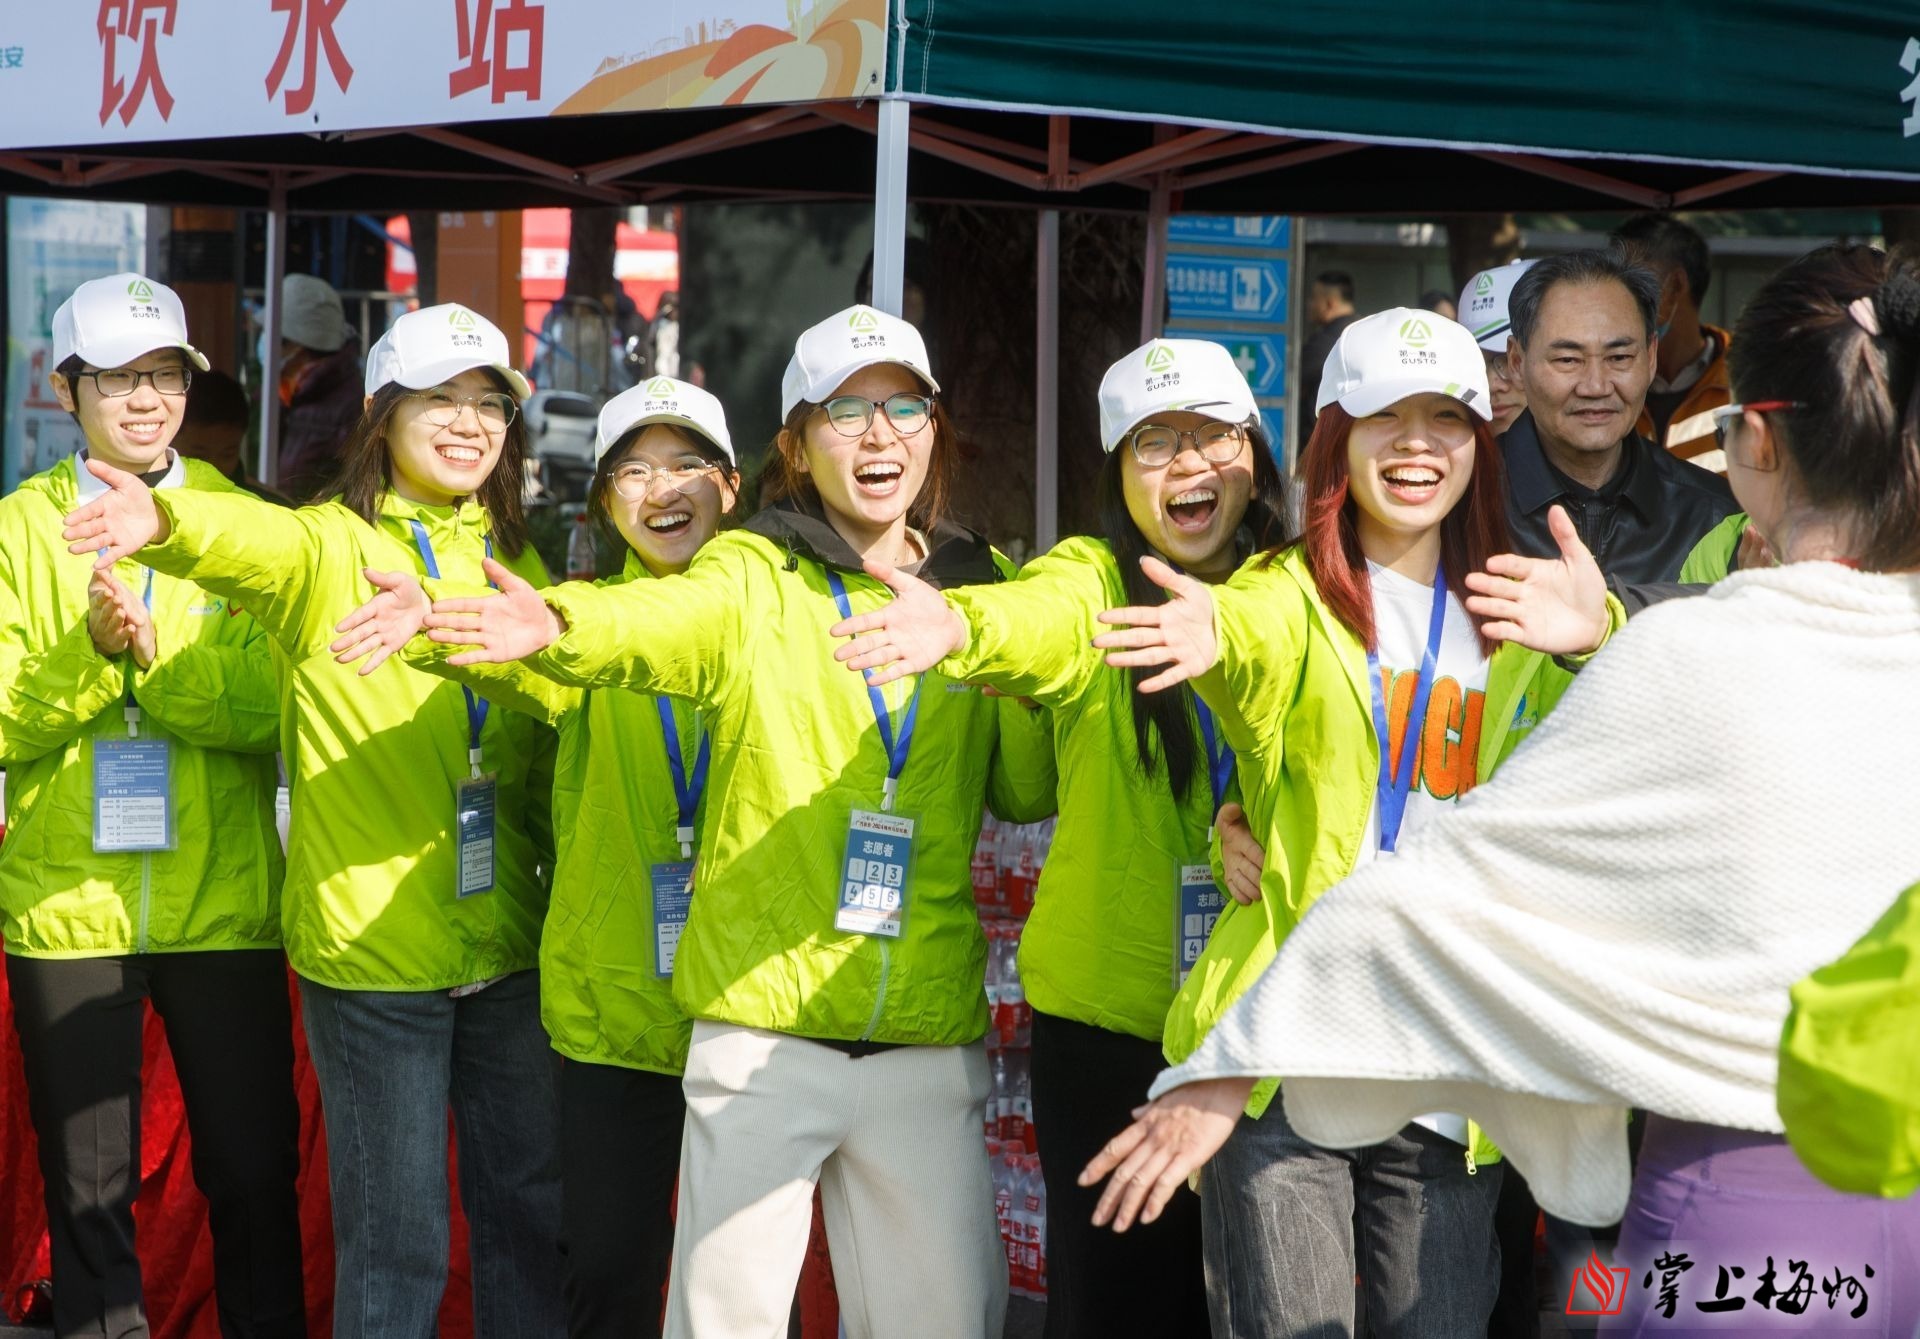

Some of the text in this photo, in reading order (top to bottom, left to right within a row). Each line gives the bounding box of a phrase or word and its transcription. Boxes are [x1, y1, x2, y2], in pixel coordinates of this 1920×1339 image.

[0, 46, 24, 69] 安
[96, 0, 545, 127] 饮水站
[1147, 380, 1180, 392] GUSTO
[862, 840, 894, 858] 志愿者
[871, 864, 880, 877] 2
[890, 867, 898, 880] 3
[850, 885, 895, 903] 4 5 6
[1189, 942, 1198, 954] 4
